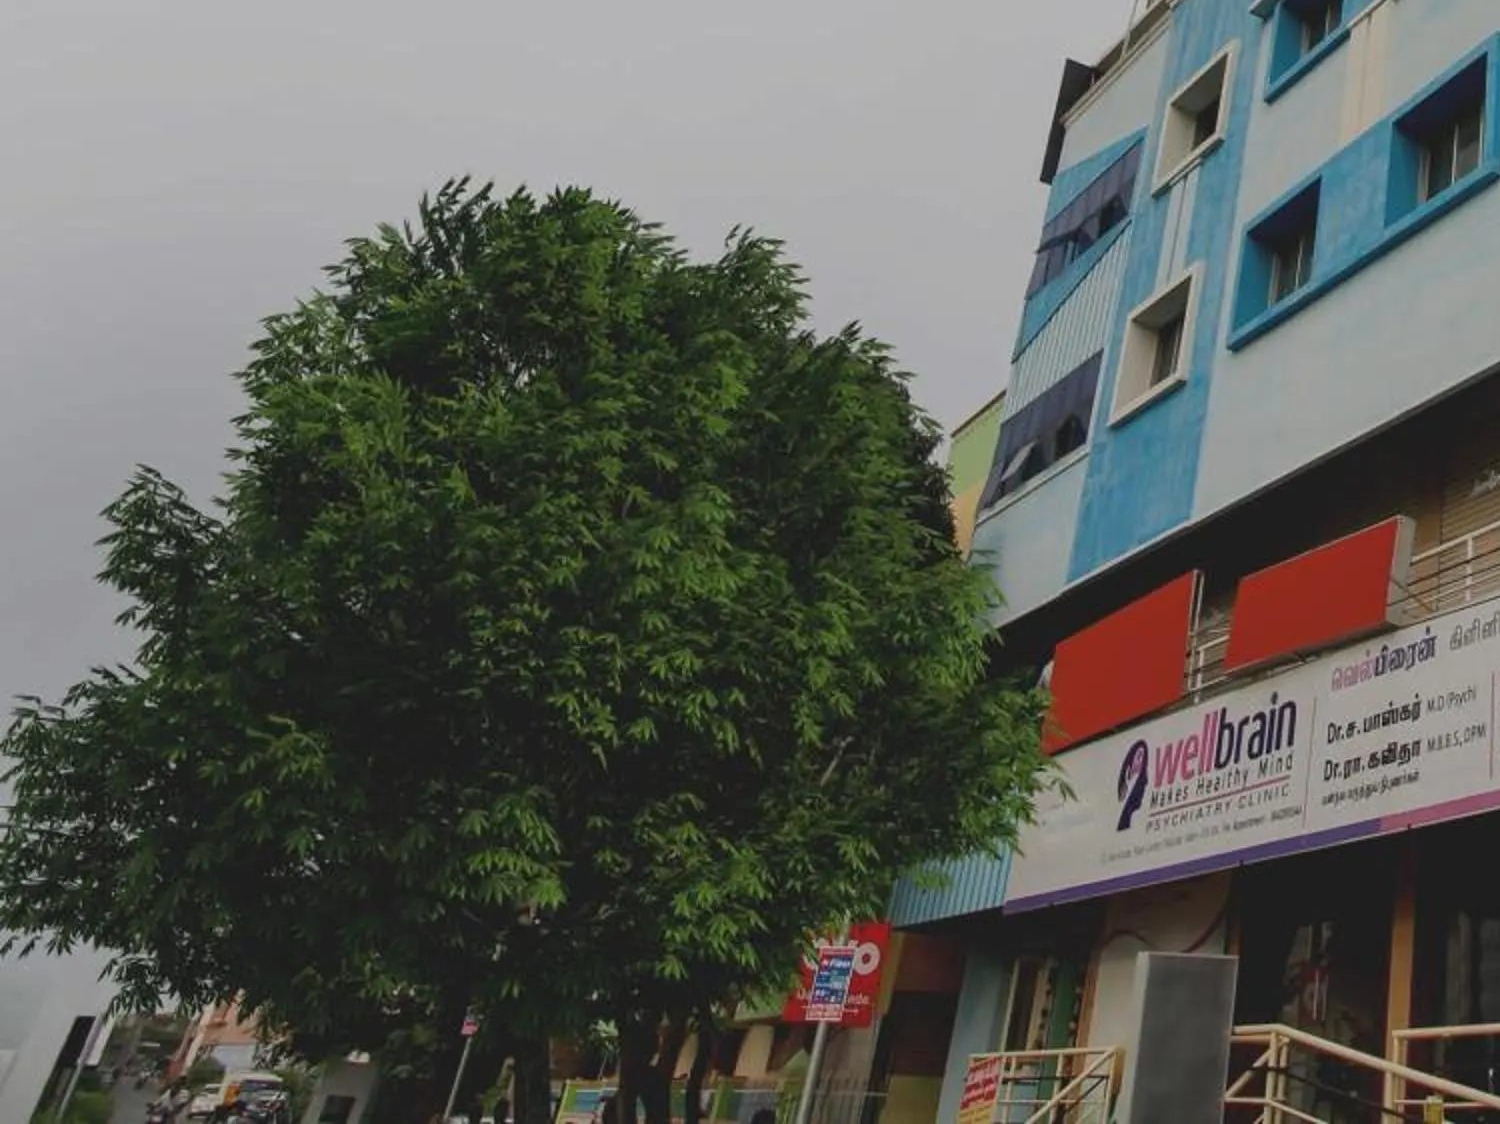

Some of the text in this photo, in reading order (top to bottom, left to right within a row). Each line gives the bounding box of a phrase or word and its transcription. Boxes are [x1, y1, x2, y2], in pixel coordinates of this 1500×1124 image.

[1153, 691, 1297, 789] wellbrain
[1144, 800, 1232, 835] PSYCHIATRY
[1237, 782, 1291, 810] CLINIC
[1151, 751, 1294, 809] Makes Healthy Mind
